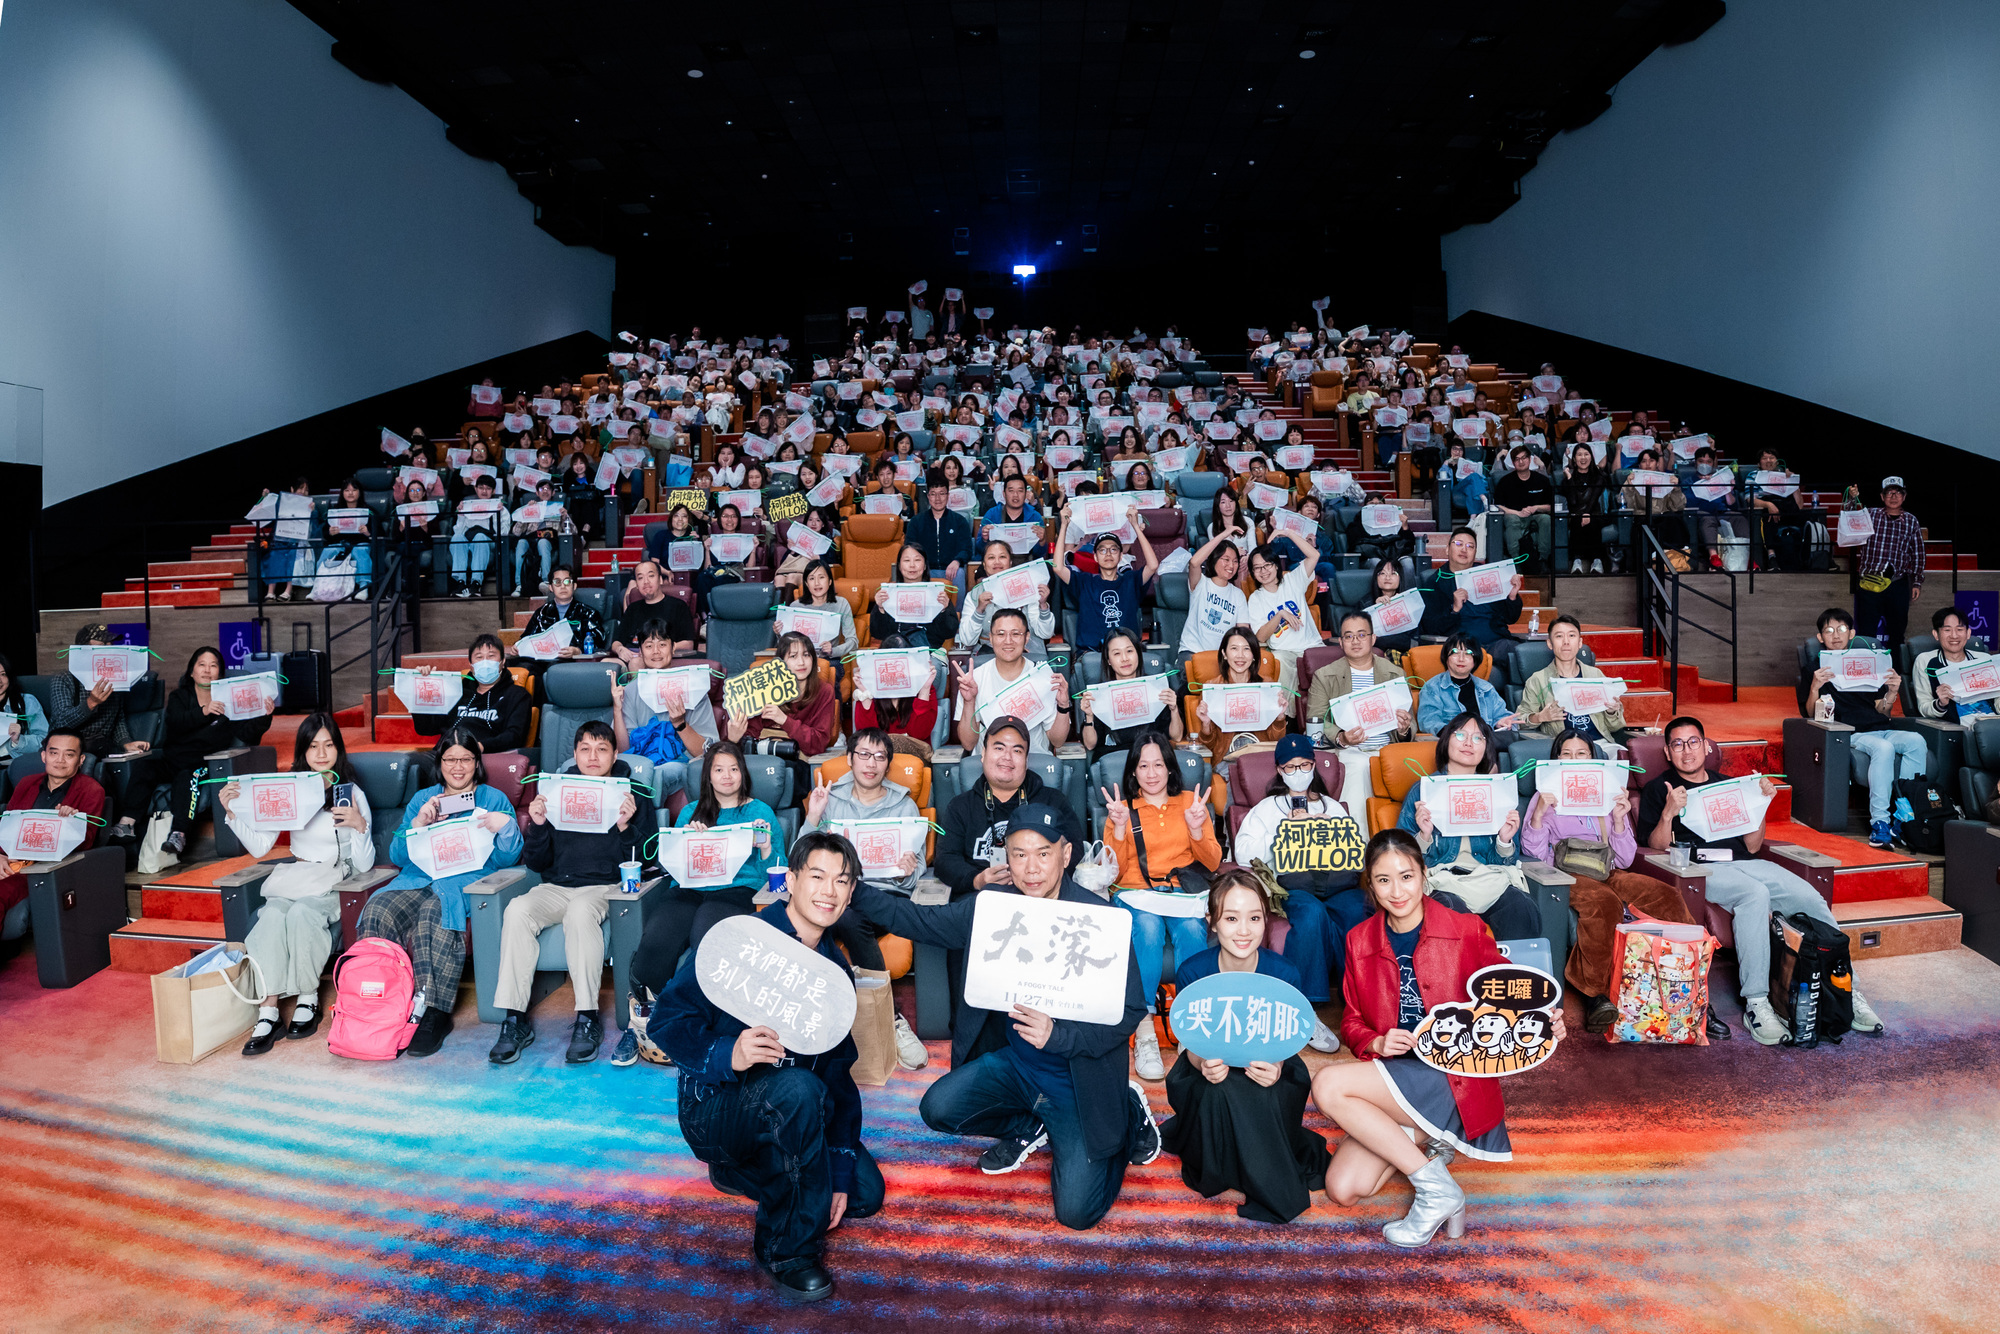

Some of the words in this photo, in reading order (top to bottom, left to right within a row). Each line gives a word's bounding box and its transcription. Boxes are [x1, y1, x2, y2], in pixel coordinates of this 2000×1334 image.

[727, 661, 788, 701] 柯煒林
[634, 765, 643, 773] 14
[766, 767, 775, 775] 13
[904, 767, 913, 775] 12
[1046, 765, 1055, 773] 11
[1186, 759, 1196, 767] 10
[1324, 760, 1330, 768] 9
[257, 787, 280, 817] 走囉
[1565, 774, 1588, 804] 走囉
[563, 790, 587, 820] 走囉
[1452, 789, 1476, 820] 走囉
[1282, 821, 1357, 849] 柯煒林
[691, 843, 713, 875] 走囉
[860, 835, 885, 865] 走囉
[1278, 848, 1363, 871] WILLOR
[738, 938, 828, 1008] 我們都是
[1024, 981, 1047, 990] FOGGY
[1048, 984, 1065, 993] TALE
[709, 957, 823, 1041] 別人的風景
[1004, 991, 1042, 1006] 11/27
[1186, 995, 1300, 1045] 哭不夠耶
